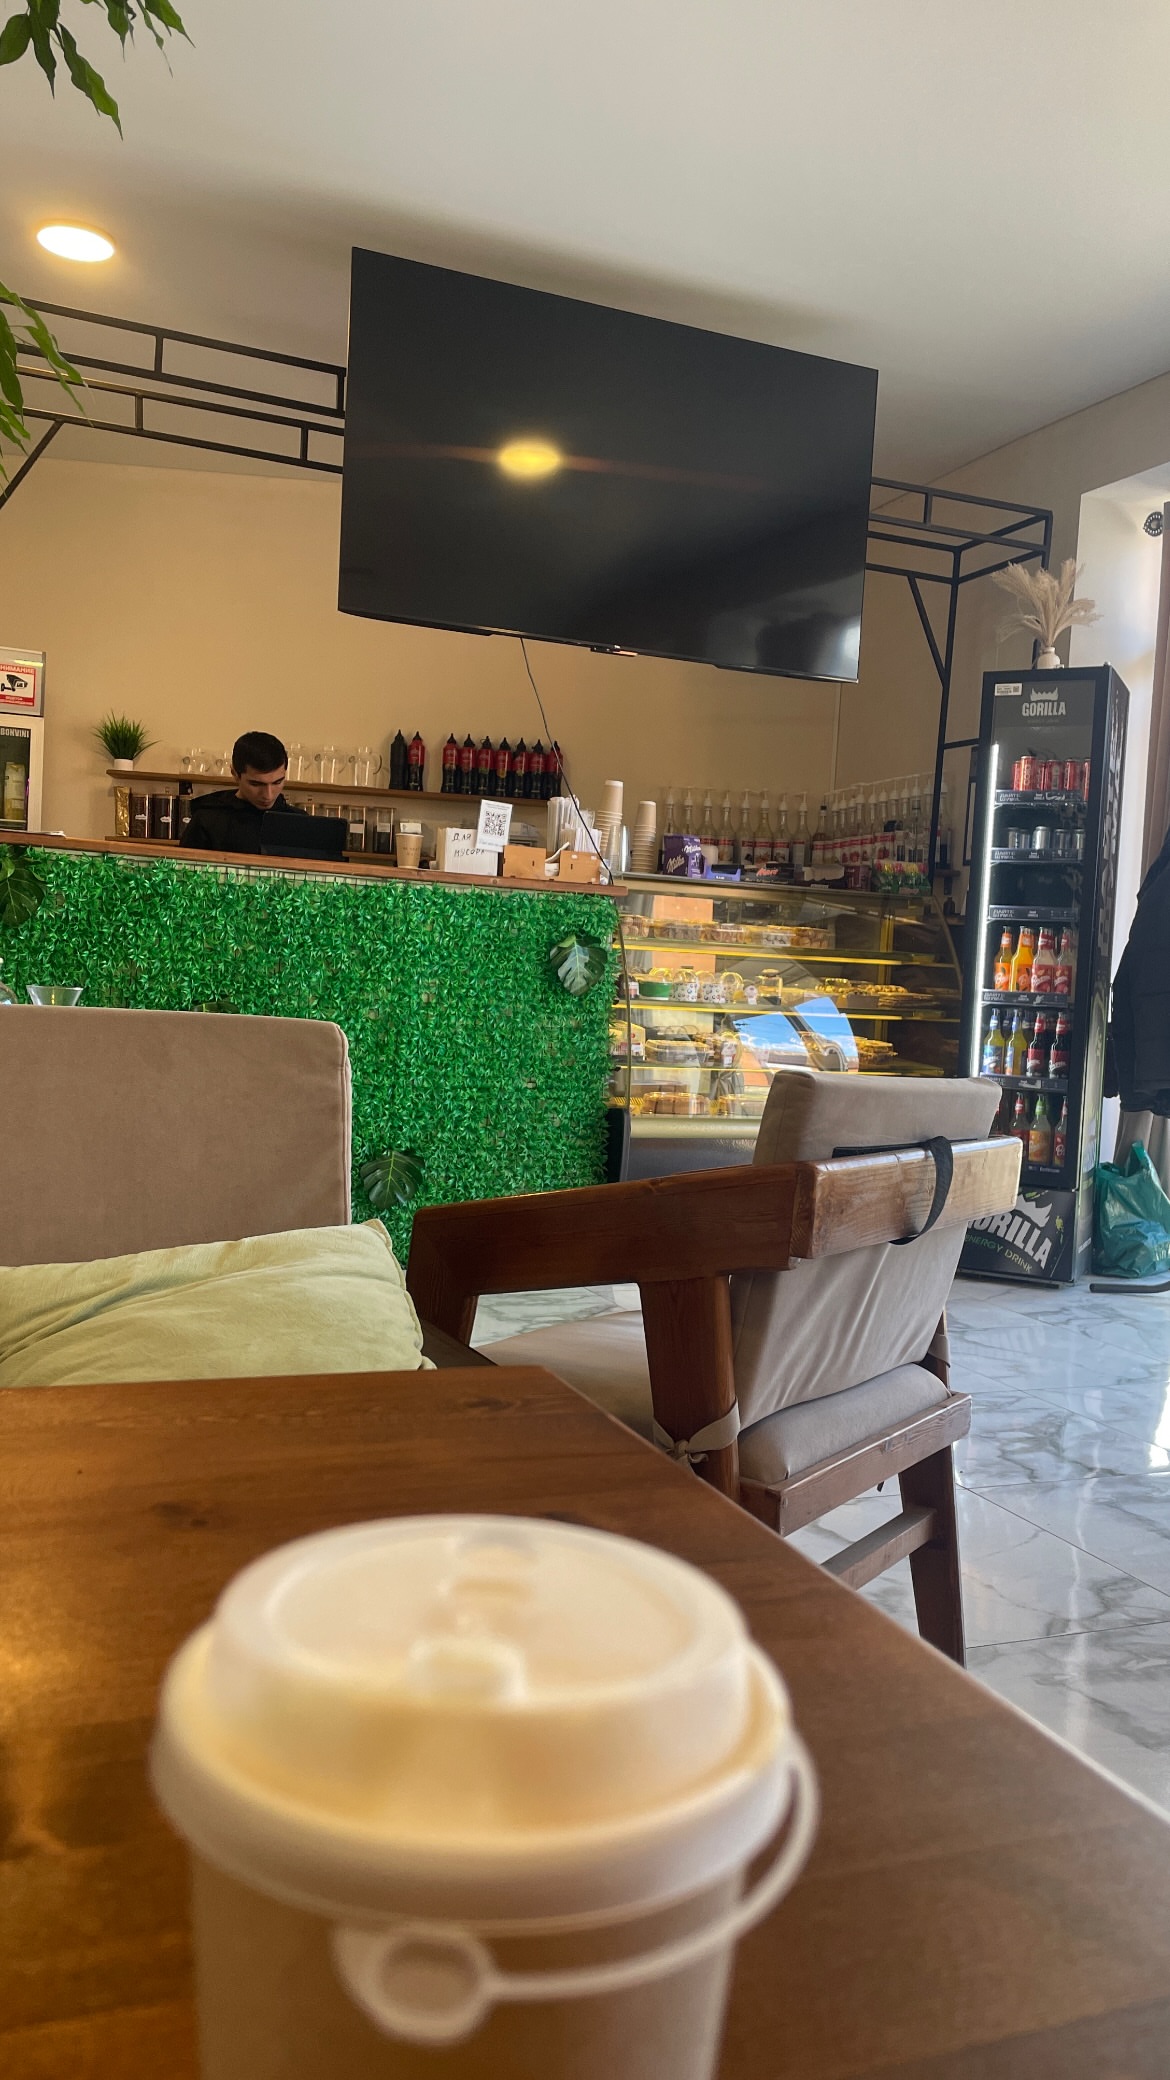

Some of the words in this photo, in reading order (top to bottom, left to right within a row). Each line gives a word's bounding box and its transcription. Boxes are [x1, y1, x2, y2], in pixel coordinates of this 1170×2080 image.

[1022, 702, 1066, 717] GORILLA
[0, 727, 30, 738] BONVINI
[452, 832, 472, 842] ДЛЯ
[1005, 1249, 1033, 1273] DRINK
